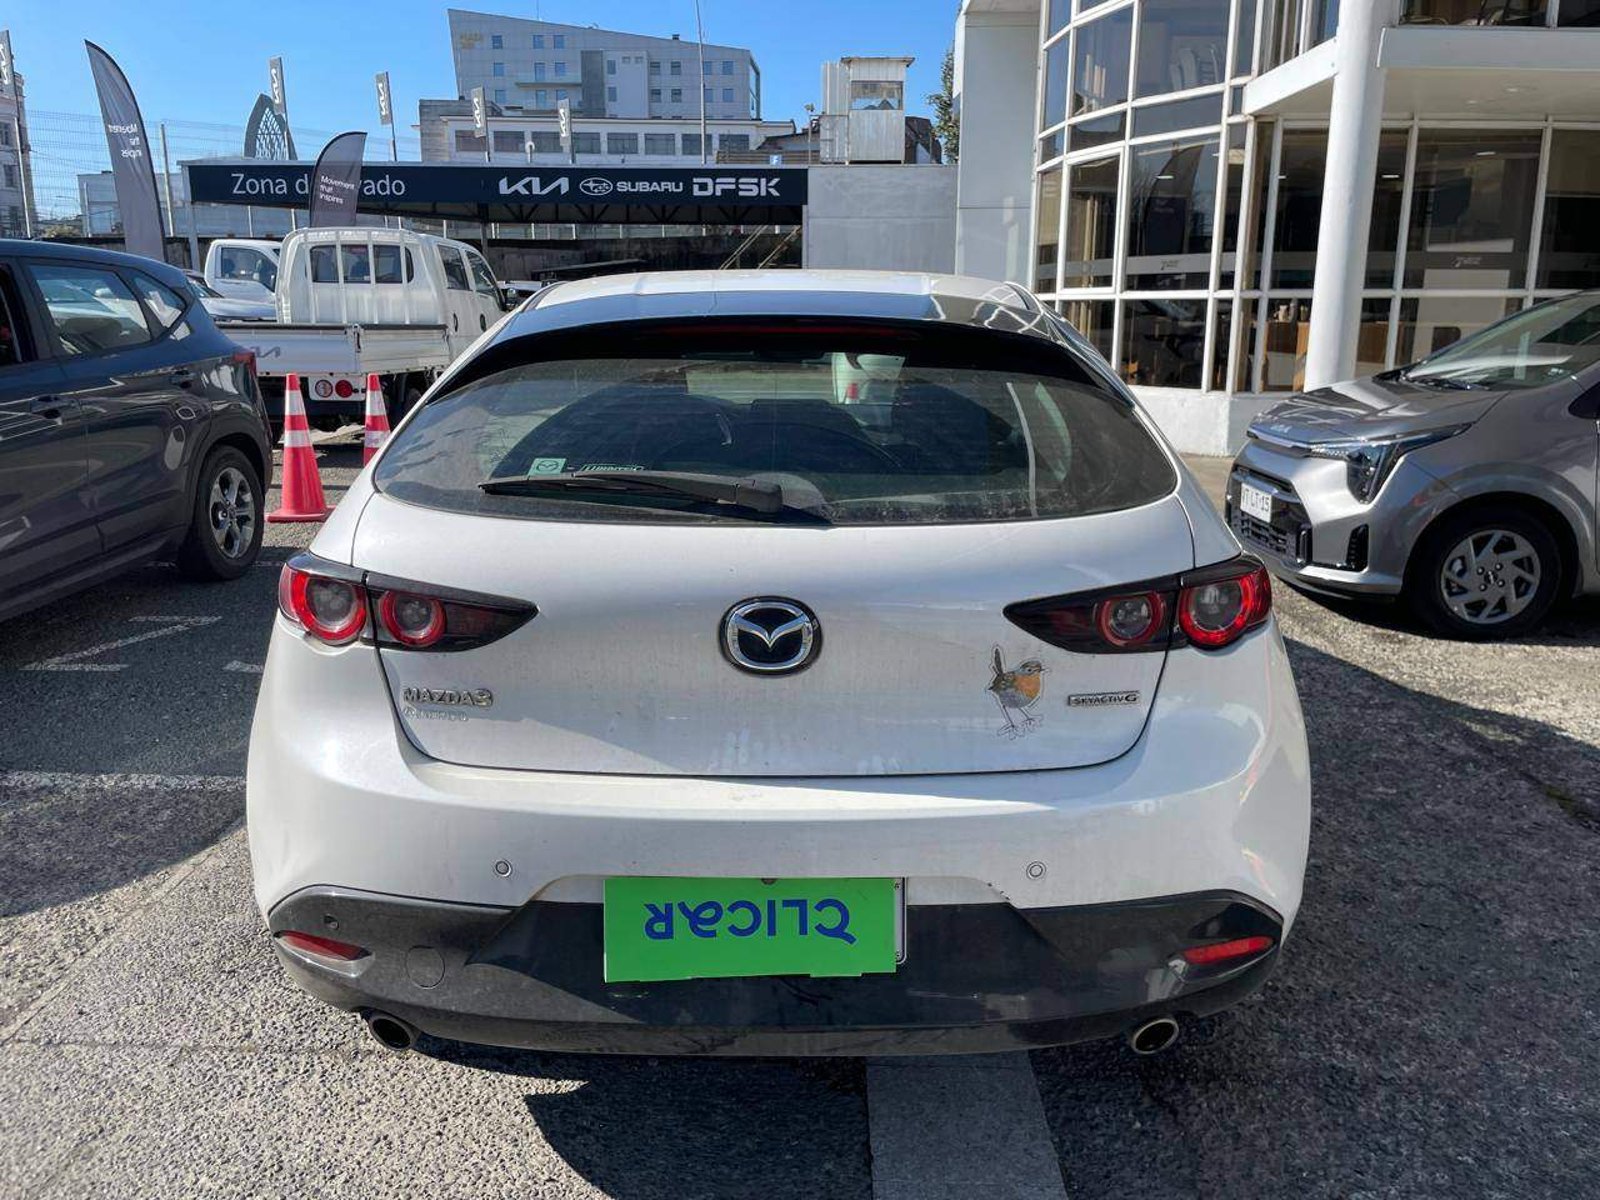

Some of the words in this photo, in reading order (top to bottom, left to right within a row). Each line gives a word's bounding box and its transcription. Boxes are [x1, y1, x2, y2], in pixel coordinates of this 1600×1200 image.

[231, 173, 288, 195] Zona
[295, 173, 309, 195] d
[498, 176, 570, 195] KIA
[616, 181, 684, 193] SUBARU
[692, 177, 781, 197] DFSK
[403, 687, 493, 708] MAZDA3
